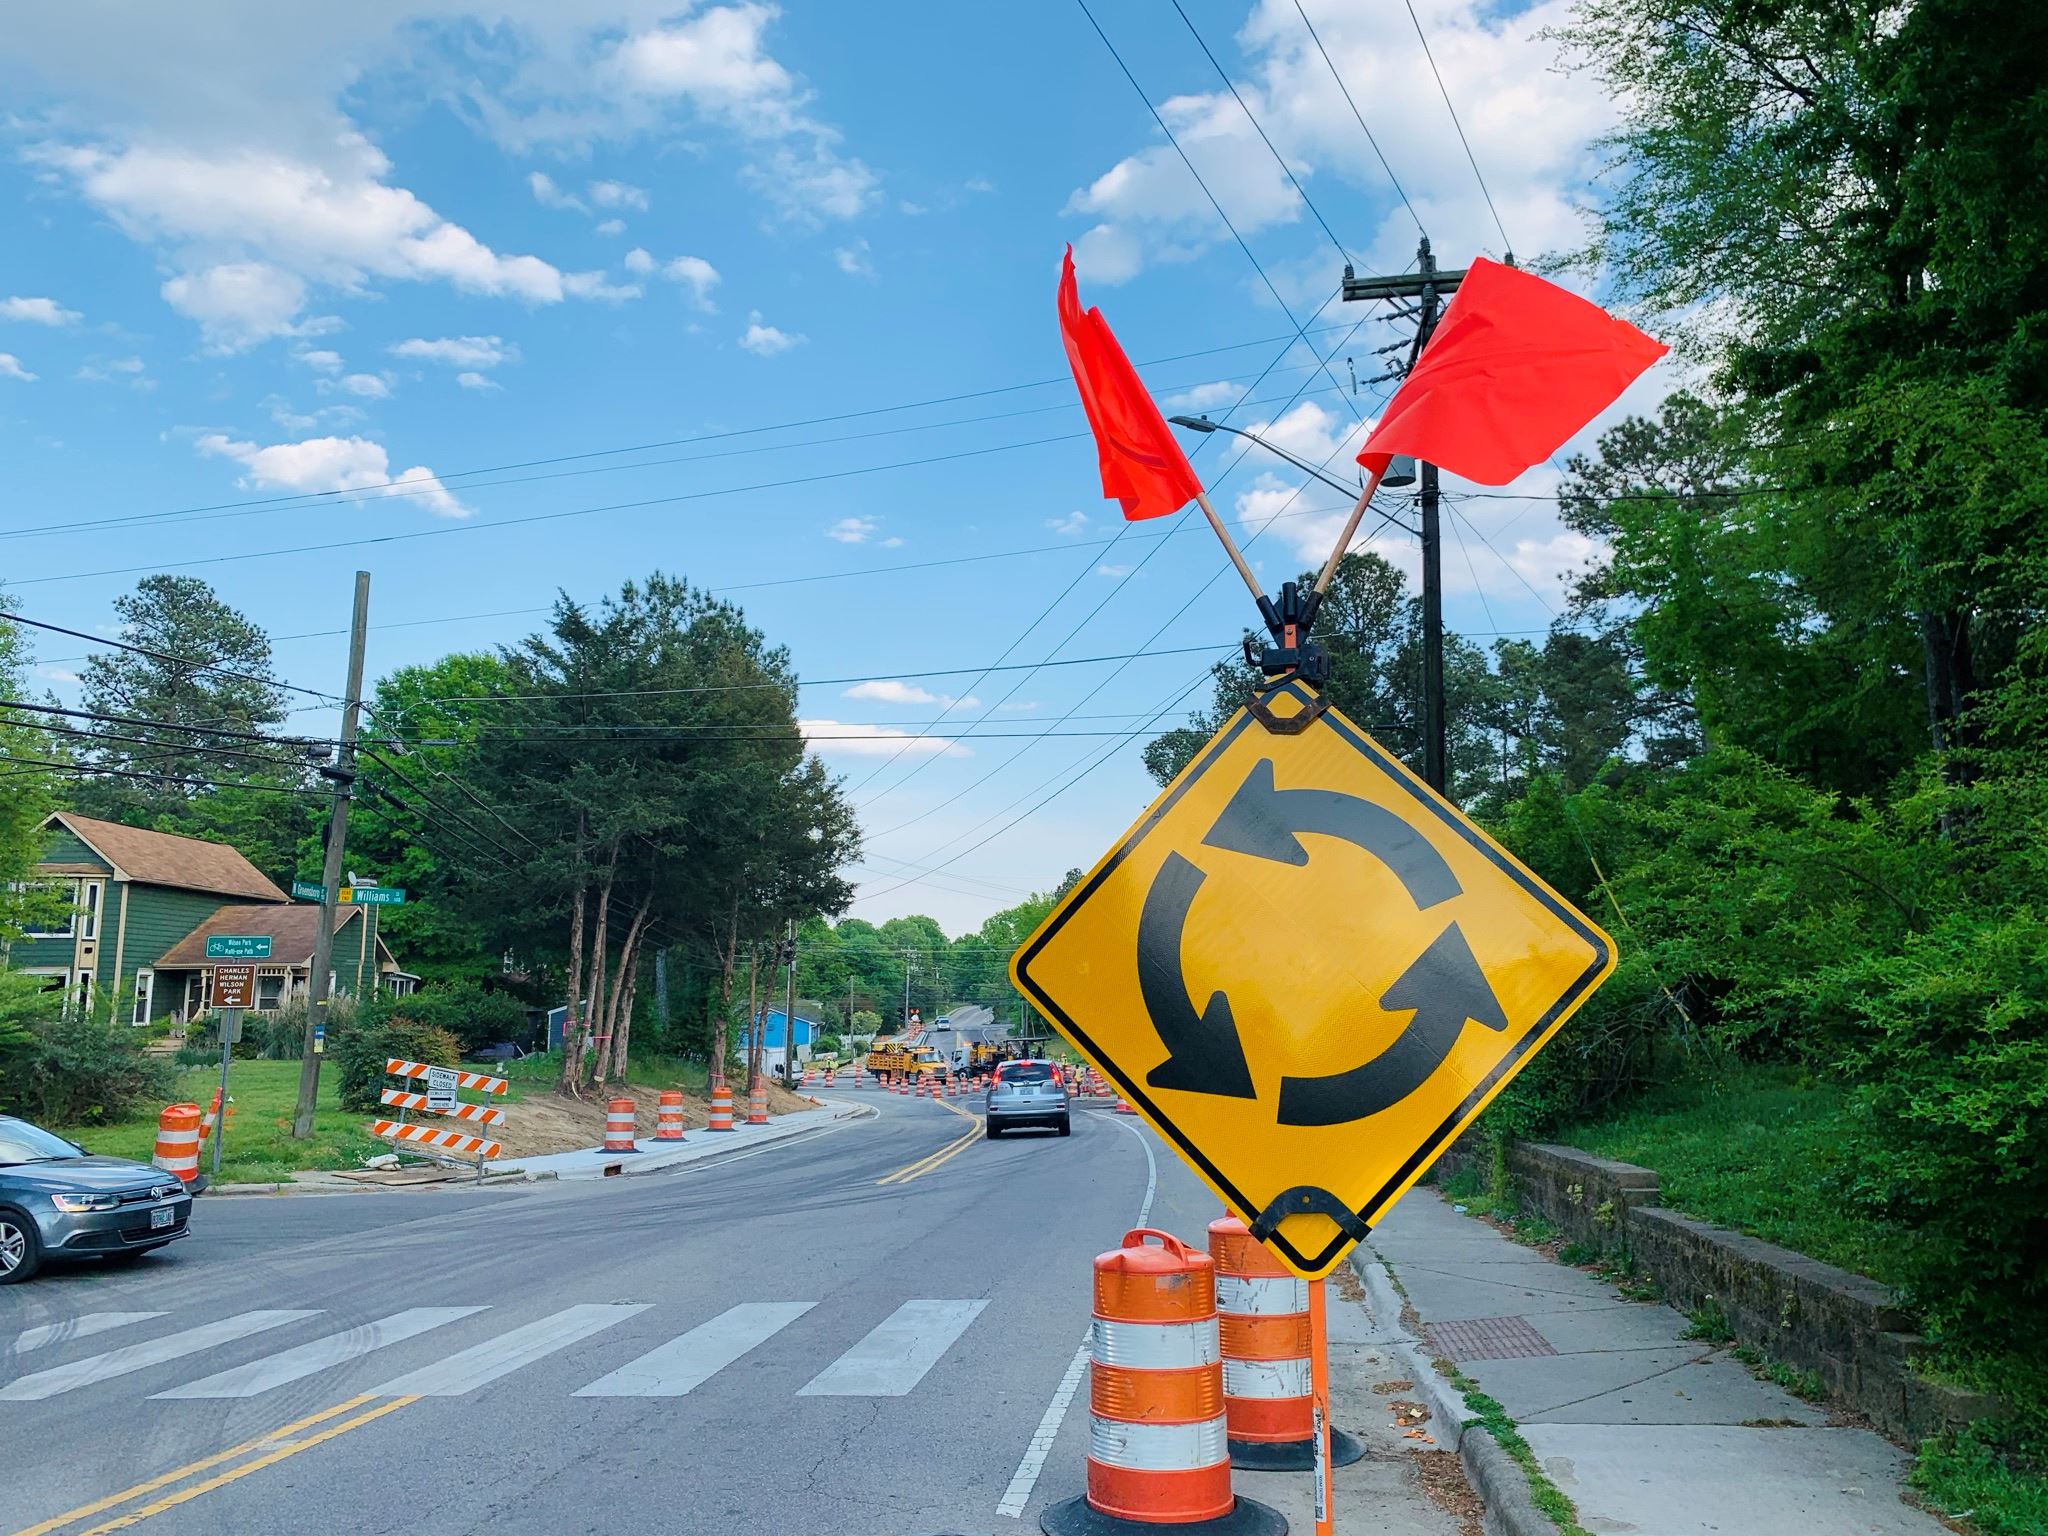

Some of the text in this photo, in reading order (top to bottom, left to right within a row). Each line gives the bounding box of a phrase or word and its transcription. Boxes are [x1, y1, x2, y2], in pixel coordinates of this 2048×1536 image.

[357, 890, 390, 902] Williams
[432, 1071, 456, 1081] SIDEWALK
[433, 1080, 452, 1088] CLOSED
